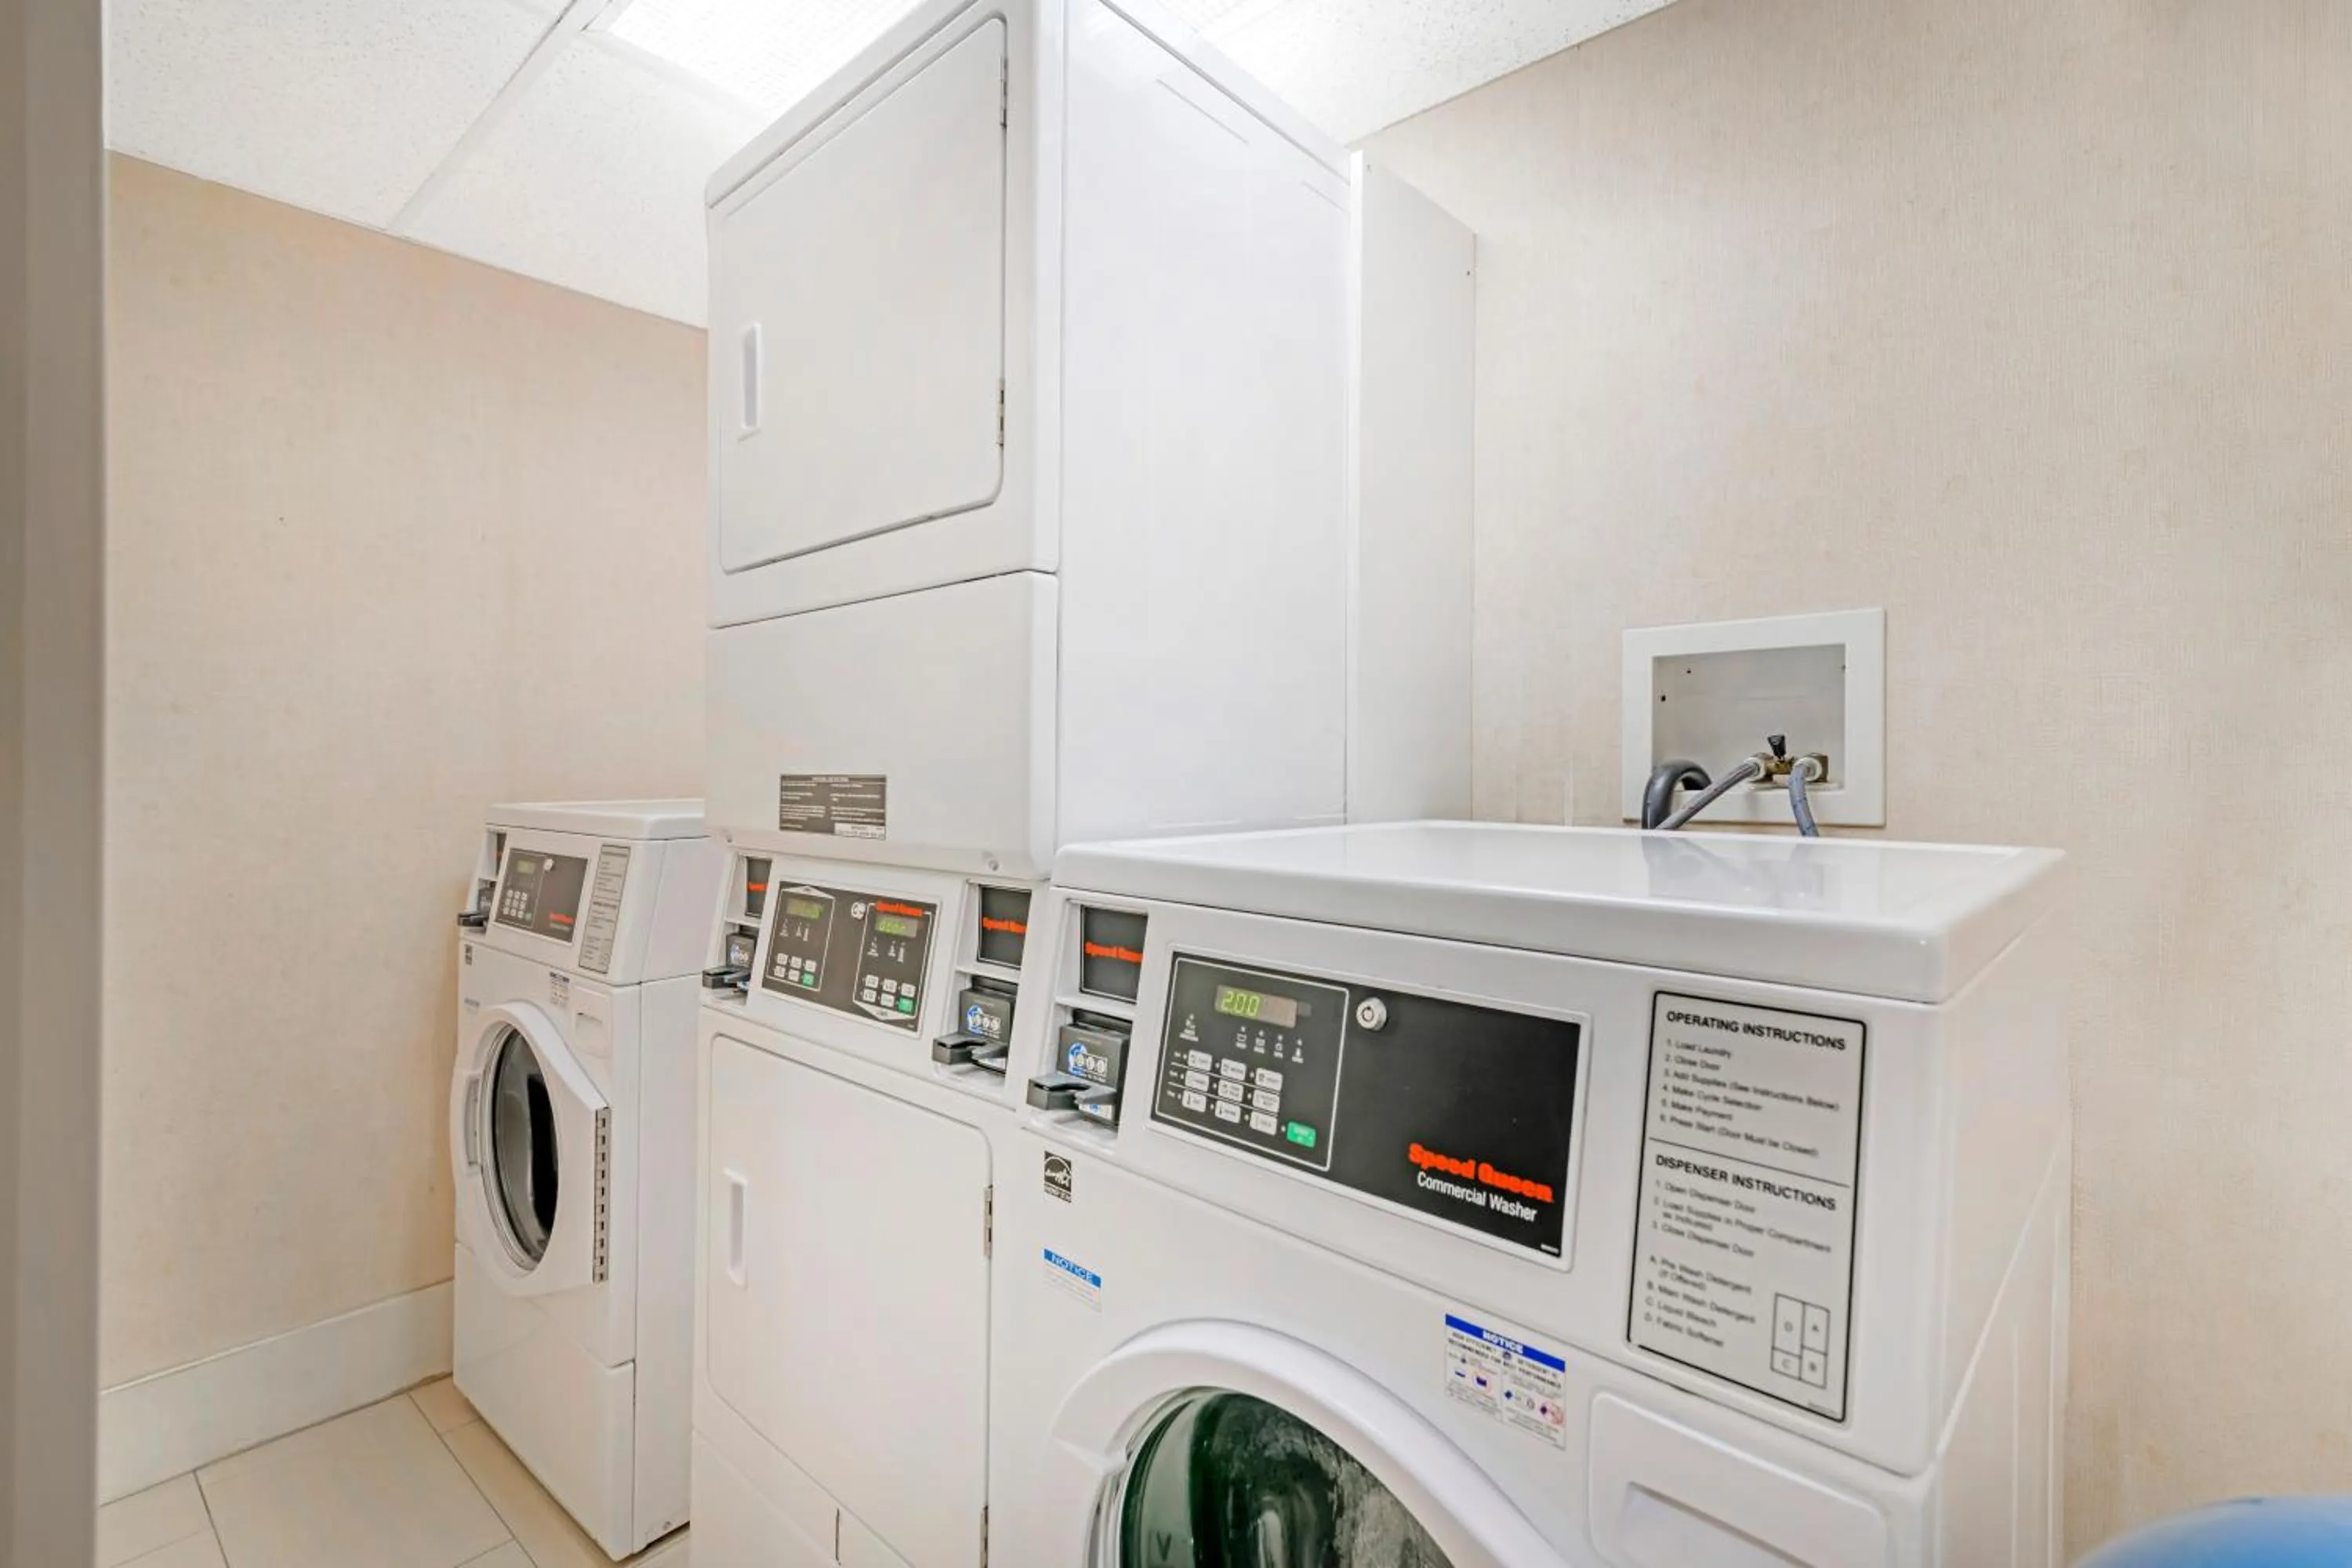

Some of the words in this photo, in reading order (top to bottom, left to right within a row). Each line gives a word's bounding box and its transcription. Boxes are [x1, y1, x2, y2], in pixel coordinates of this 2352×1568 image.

[1666, 1011, 1739, 1033] OPERATING
[1743, 1022, 1846, 1051] INSTRUCTIONS
[1409, 1142, 1475, 1179] Speed
[1478, 1163, 1553, 1203] Queen
[1417, 1171, 1486, 1207] Commercial
[1490, 1193, 1538, 1222] Washer
[1655, 1153, 1729, 1182] DISPENSER
[1732, 1174, 1837, 1211] INSTRUCTIONS
[1051, 1254, 1093, 1282] NOTICE
